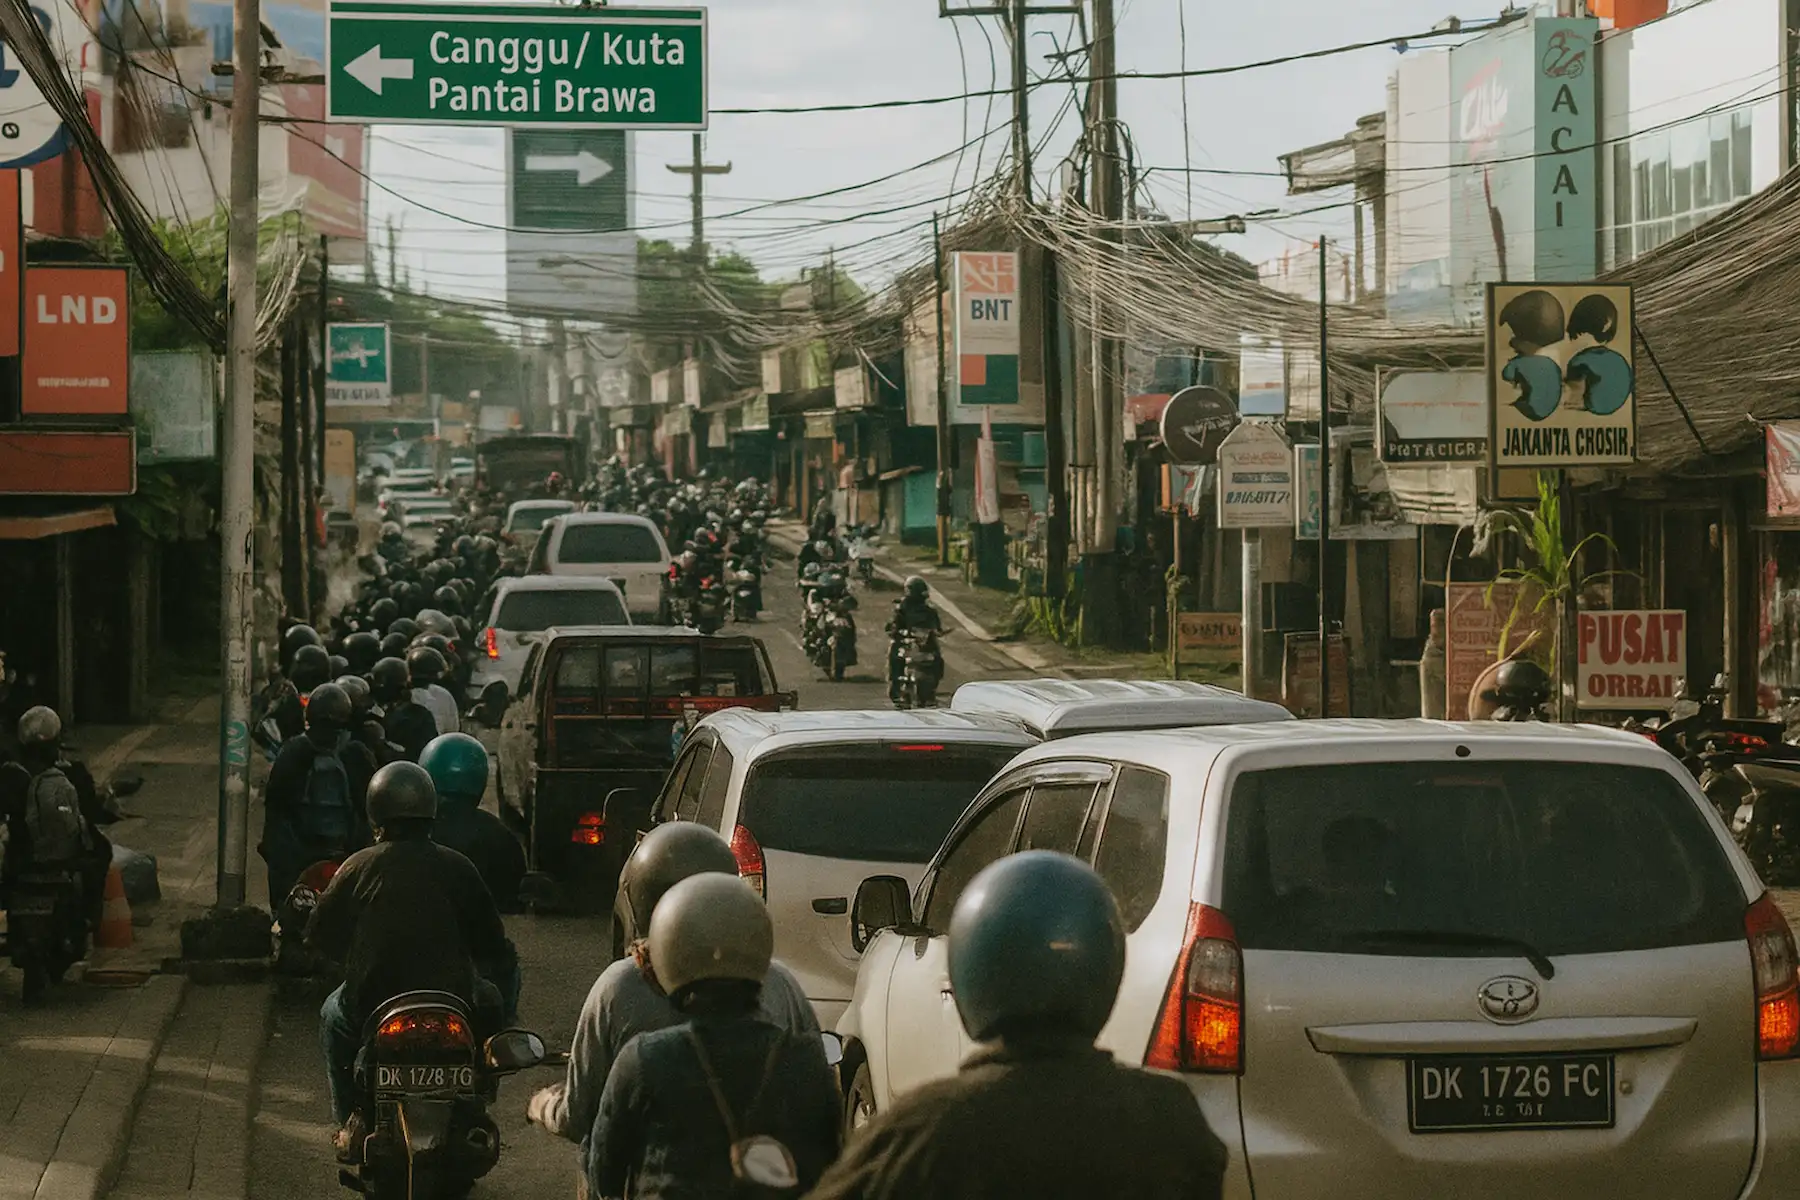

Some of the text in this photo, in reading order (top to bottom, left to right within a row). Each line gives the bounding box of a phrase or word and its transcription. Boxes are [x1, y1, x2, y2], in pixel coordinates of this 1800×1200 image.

[603, 32, 686, 66] Kuta
[428, 77, 656, 113] Pantai Brawa
[37, 295, 117, 324] LND
[971, 299, 1012, 321] BNT
[1578, 613, 1683, 665] PUSAT
[379, 1067, 402, 1086] DK
[1422, 1063, 1600, 1100] DK 1726 FC
